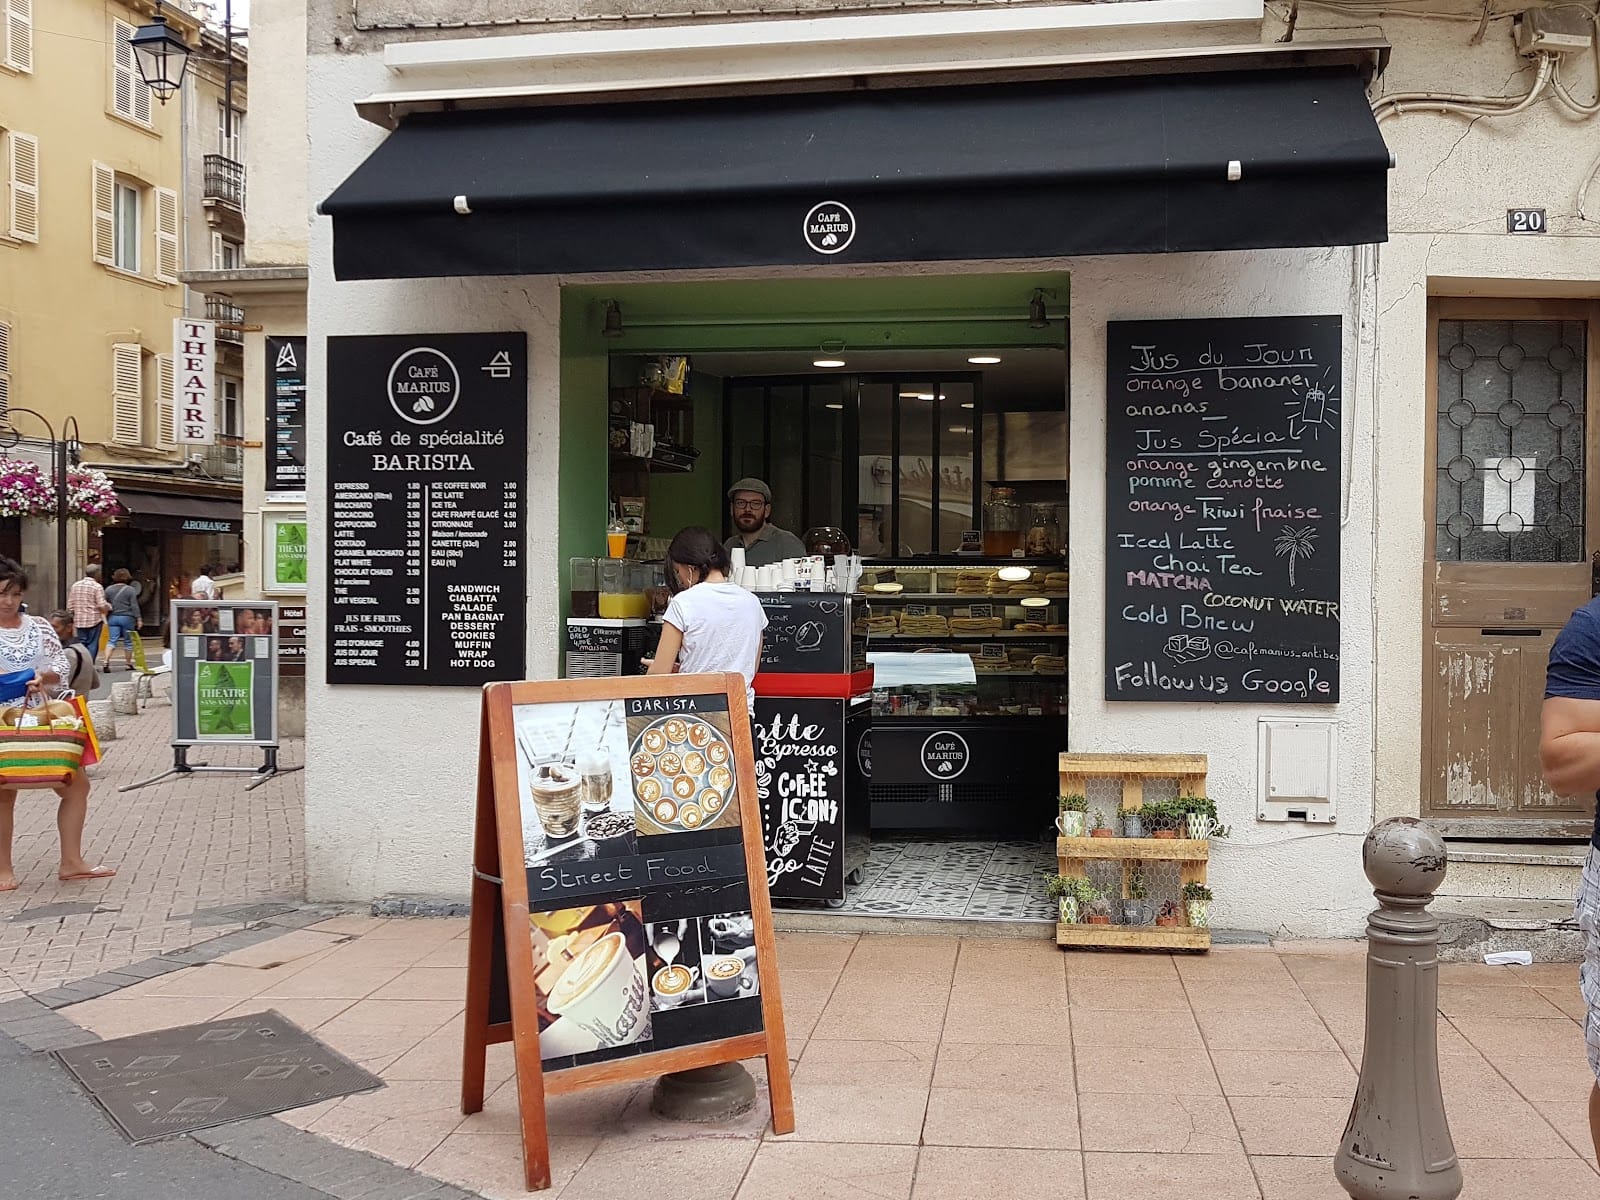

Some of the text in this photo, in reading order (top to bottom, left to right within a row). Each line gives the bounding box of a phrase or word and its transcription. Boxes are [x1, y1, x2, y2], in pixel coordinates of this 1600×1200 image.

[817, 212, 841, 223] CAFÉ
[1513, 211, 1541, 231] 20
[810, 223, 849, 233] MARIUS
[1130, 342, 1314, 371] Jus du Jour
[408, 364, 439, 379] CAFÉ
[182, 323, 207, 439] THEATRE
[1126, 367, 1304, 398] orange banane
[396, 381, 451, 394] MARIUS
[1125, 400, 1209, 417] ananas
[343, 428, 505, 449] Café de spécialité
[1135, 429, 1183, 451] Jus
[371, 453, 475, 471] BARISTA
[1126, 456, 1327, 479] orange gingembre
[431, 482, 443, 490] ICE
[443, 482, 470, 490] COFFEE
[470, 482, 488, 490] NOIR
[1128, 474, 1285, 495] pomme carotte
[431, 501, 443, 509] ICE
[444, 501, 458, 509] TEA
[450, 510, 477, 519] FRAPPÉ
[477, 510, 500, 519] GLACÉ
[503, 511, 517, 519] 4.50
[1128, 497, 1323, 532] orange kiwi fraise
[182, 519, 231, 532] AROMANGE
[431, 520, 474, 528] CITRONNADE
[333, 530, 355, 538] LATTE
[503, 540, 517, 548] 2.00
[1117, 531, 1235, 550] Iced Latte
[431, 549, 446, 557] EAU
[503, 550, 517, 558] 2.00
[333, 559, 350, 567] FLAT
[350, 559, 373, 567] WHITE
[431, 559, 446, 567] EAU
[503, 559, 517, 567] 2.50
[1153, 554, 1263, 576] Chai Tea
[334, 568, 370, 576] CHOCOLAT
[1126, 569, 1213, 592] MATCHA
[447, 584, 501, 593] SANDWICH
[333, 596, 349, 605] LAIT
[449, 594, 498, 603] CIABATTA
[453, 603, 494, 612] SALADE
[1203, 591, 1339, 622] COCONUT WATER
[343, 614, 402, 624] JUS DE FRUITS
[441, 612, 505, 621] PAN BAGNAT
[1122, 604, 1254, 632] Cold Brew
[333, 624, 413, 633] FRAIS SMOOTHIES
[450, 622, 496, 631] DESSERT
[568, 626, 588, 634] COLD
[451, 631, 496, 640] COOKIES
[333, 639, 348, 648] JUS
[454, 641, 492, 649] MUFFIN
[333, 649, 348, 657] JUS
[348, 649, 359, 657] DU
[359, 649, 379, 657] JOUR
[458, 650, 488, 659] WRAP
[333, 658, 348, 667] JUS
[450, 659, 496, 668] HOT DOG
[1114, 660, 1331, 698] Follow us Google
[200, 688, 248, 698] THEATRE
[760, 737, 838, 763] Espresso
[934, 741, 956, 751] CAFÉ
[927, 752, 964, 761] MARIUS
[777, 771, 829, 798] COFFEE
[801, 834, 835, 887] LATTE
[540, 855, 718, 892] Street Food
